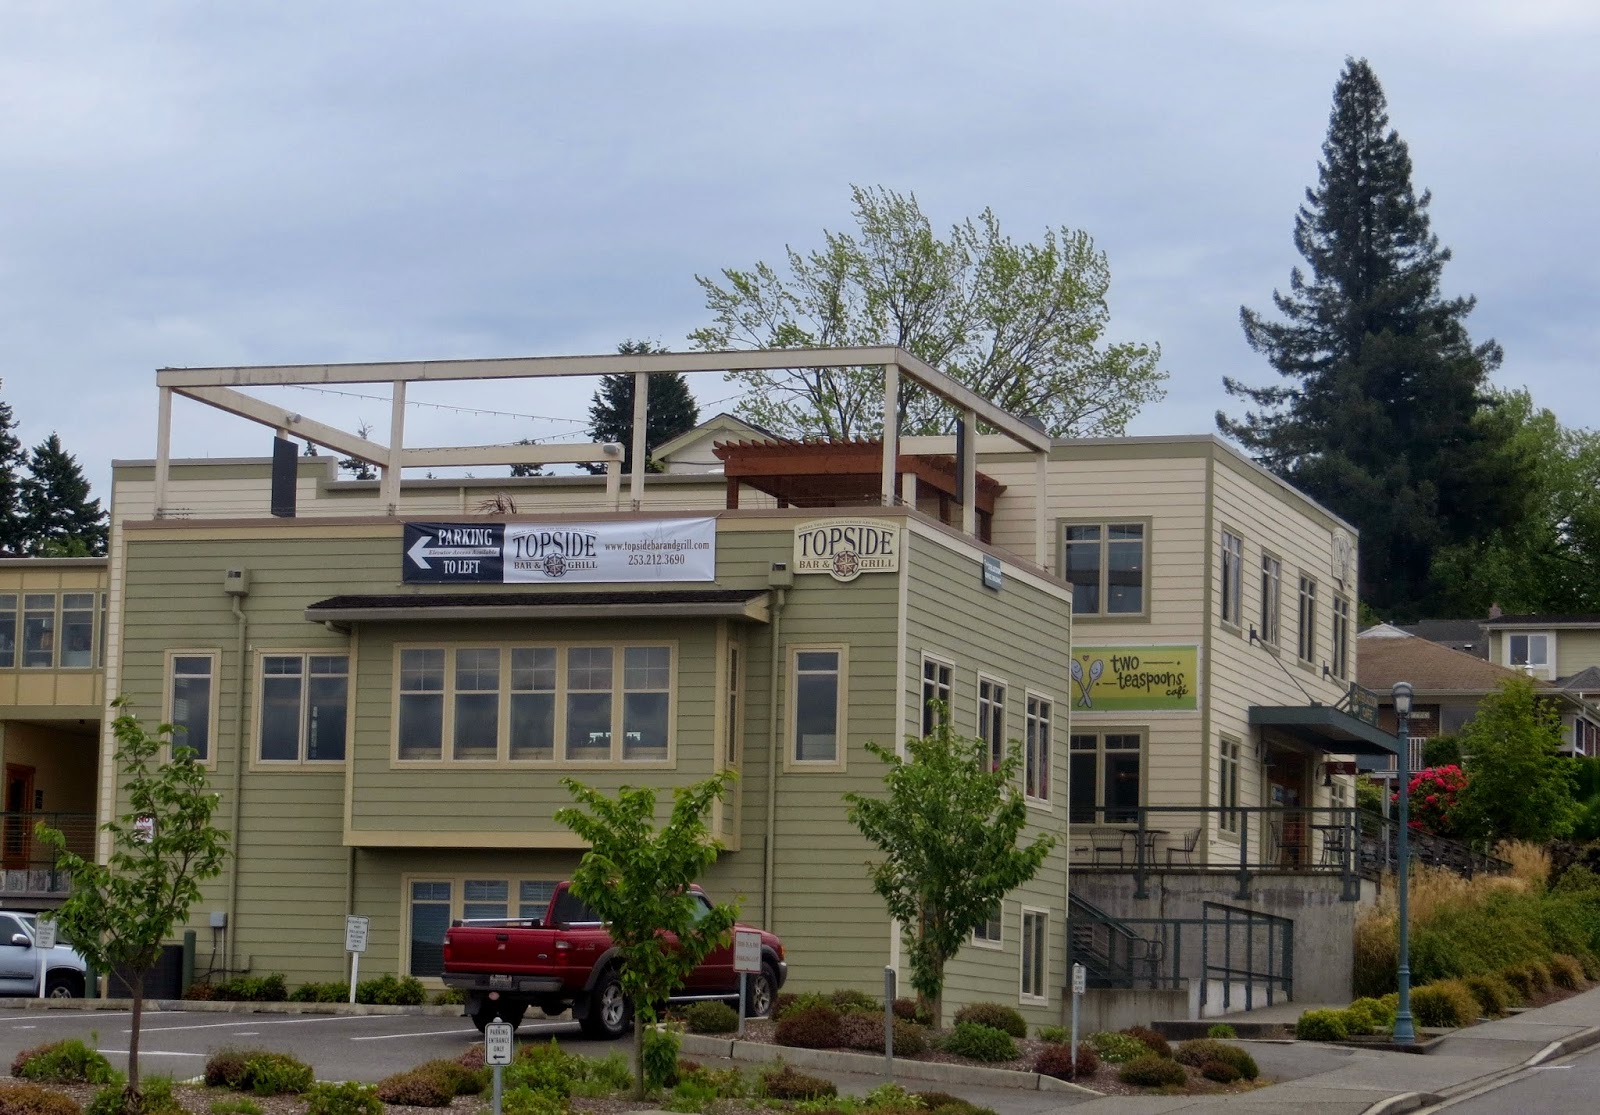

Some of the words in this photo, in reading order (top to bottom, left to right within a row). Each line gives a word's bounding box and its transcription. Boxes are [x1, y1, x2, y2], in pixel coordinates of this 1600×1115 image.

[438, 529, 492, 546] PARKING
[512, 532, 596, 558] TOPSIDE
[798, 527, 894, 556] TOPSIDE
[604, 539, 710, 552] www.topsidebarandgrill.com
[444, 560, 456, 574] TO
[458, 560, 480, 574] LEFT
[628, 554, 685, 566] 253.212.3690
[861, 560, 894, 568] GRILL
[1110, 655, 1139, 673] two
[1117, 672, 1184, 693] teaspoons
[1166, 685, 1189, 699] café
